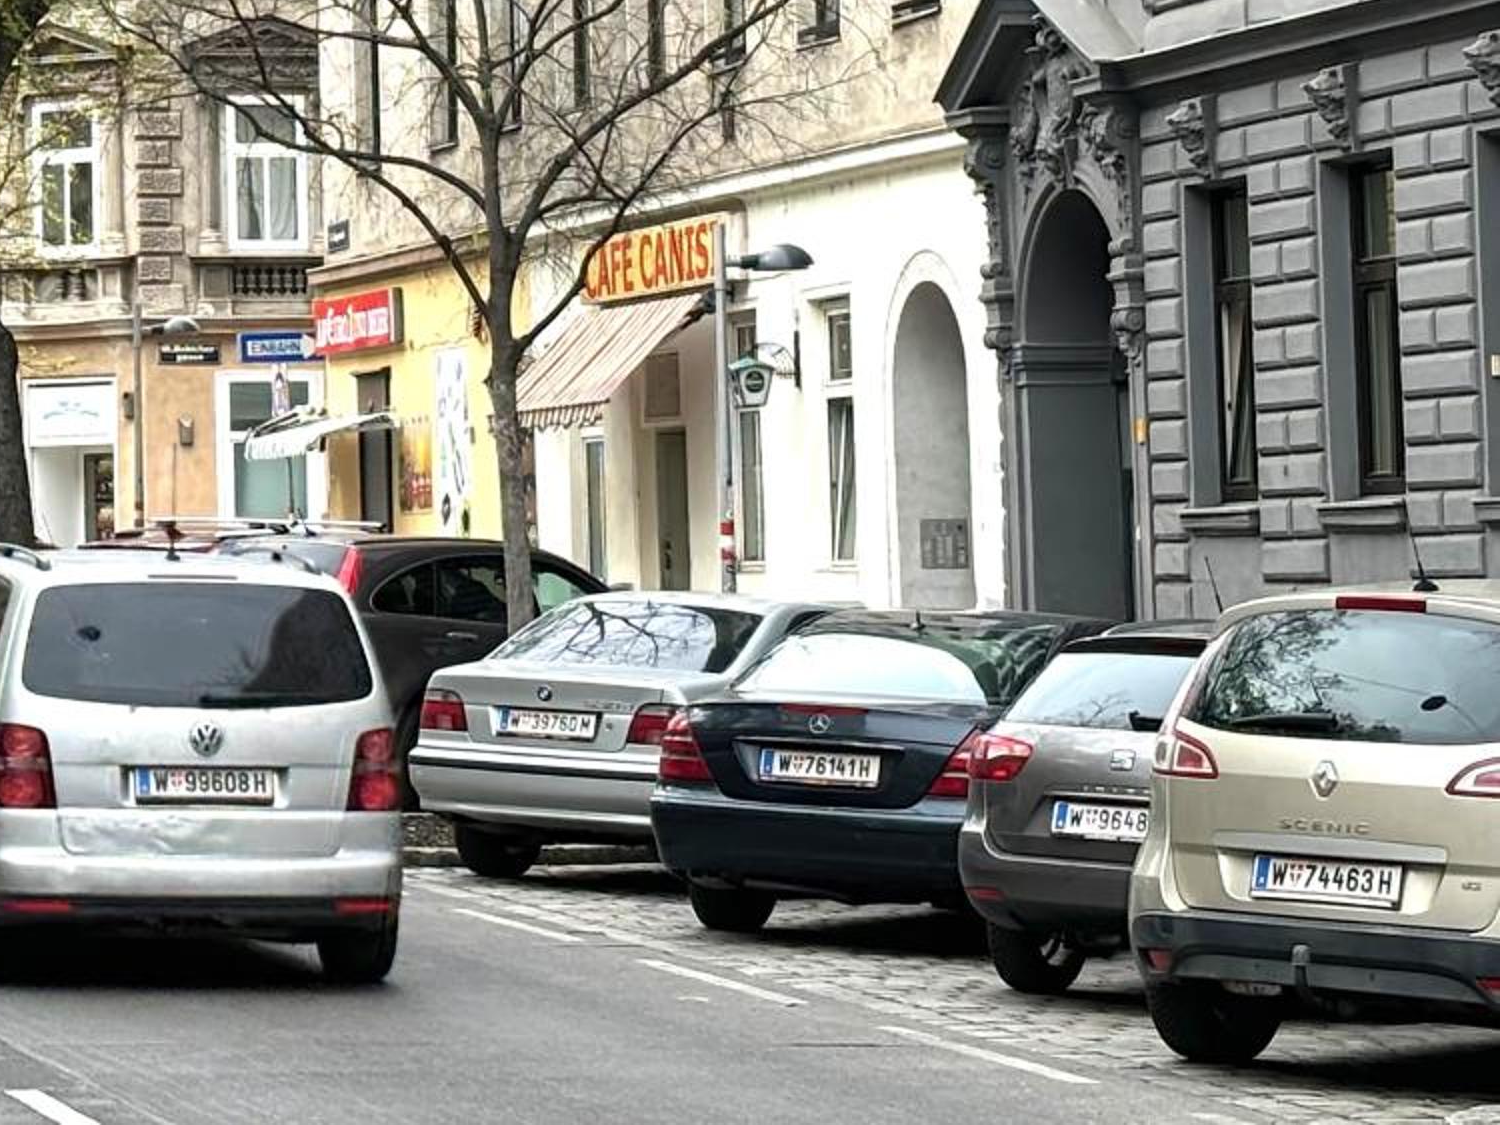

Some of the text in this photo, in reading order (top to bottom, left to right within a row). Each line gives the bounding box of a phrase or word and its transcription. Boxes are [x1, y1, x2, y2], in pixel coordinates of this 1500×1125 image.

[780, 753, 792, 772] W
[154, 771, 169, 792] W
[1070, 806, 1084, 827] W
[1279, 818, 1370, 835] SCENIC
[1271, 861, 1288, 886] W
